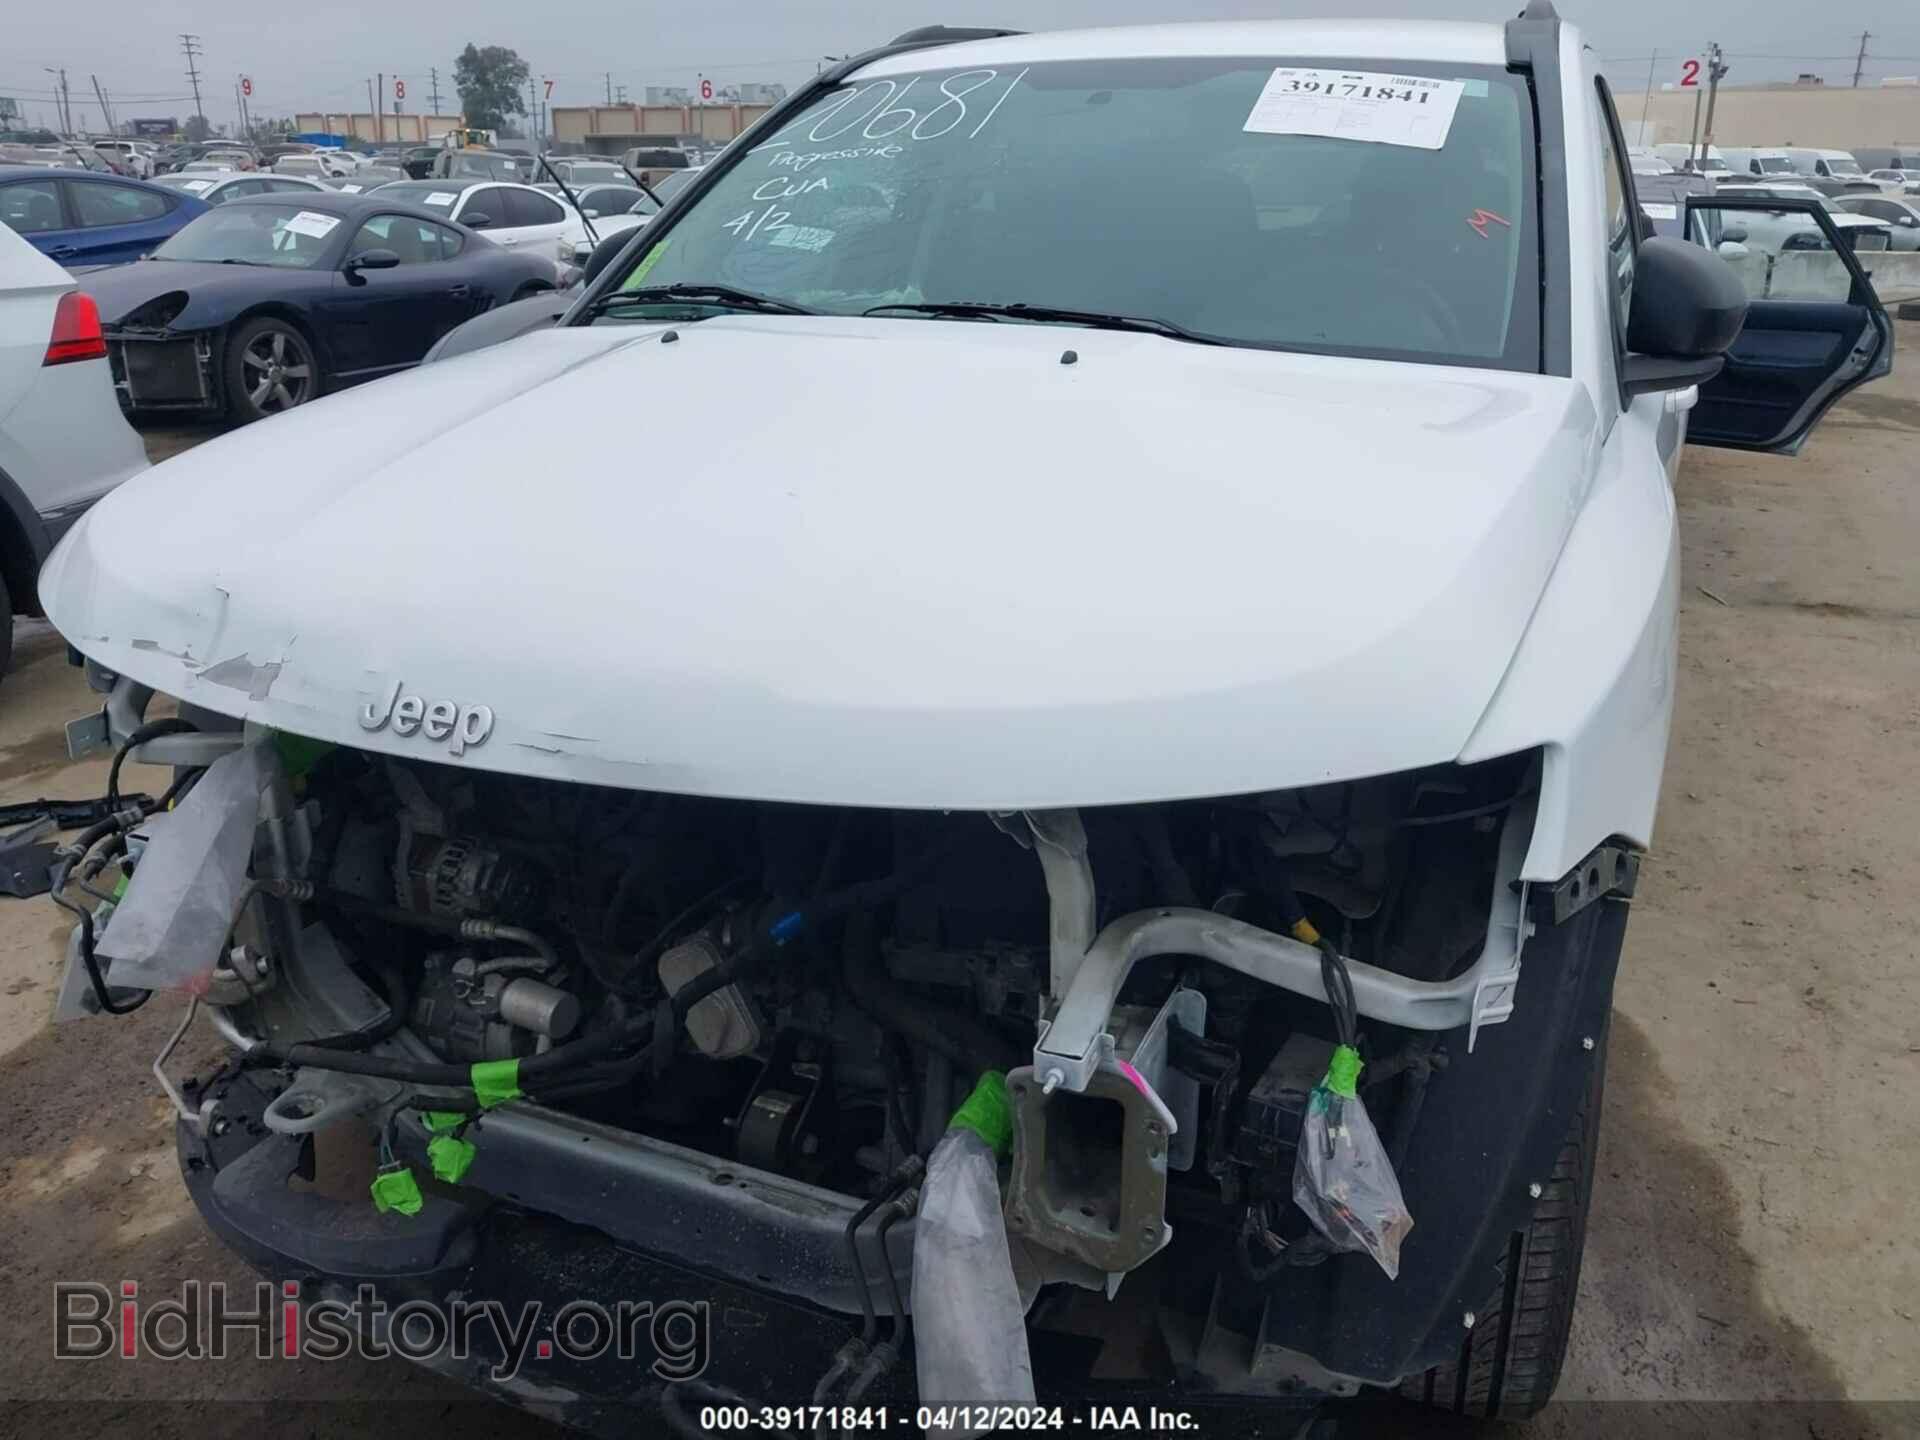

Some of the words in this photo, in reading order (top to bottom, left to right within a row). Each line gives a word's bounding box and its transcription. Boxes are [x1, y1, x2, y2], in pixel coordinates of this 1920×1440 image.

[1681, 60, 1700, 86] 2
[242, 78, 252, 96] 9
[396, 81, 405, 99] 8
[544, 80, 553, 99] 7
[701, 80, 712, 99] 6
[1282, 79, 1430, 104] 39171841
[359, 680, 495, 757] Jeep
